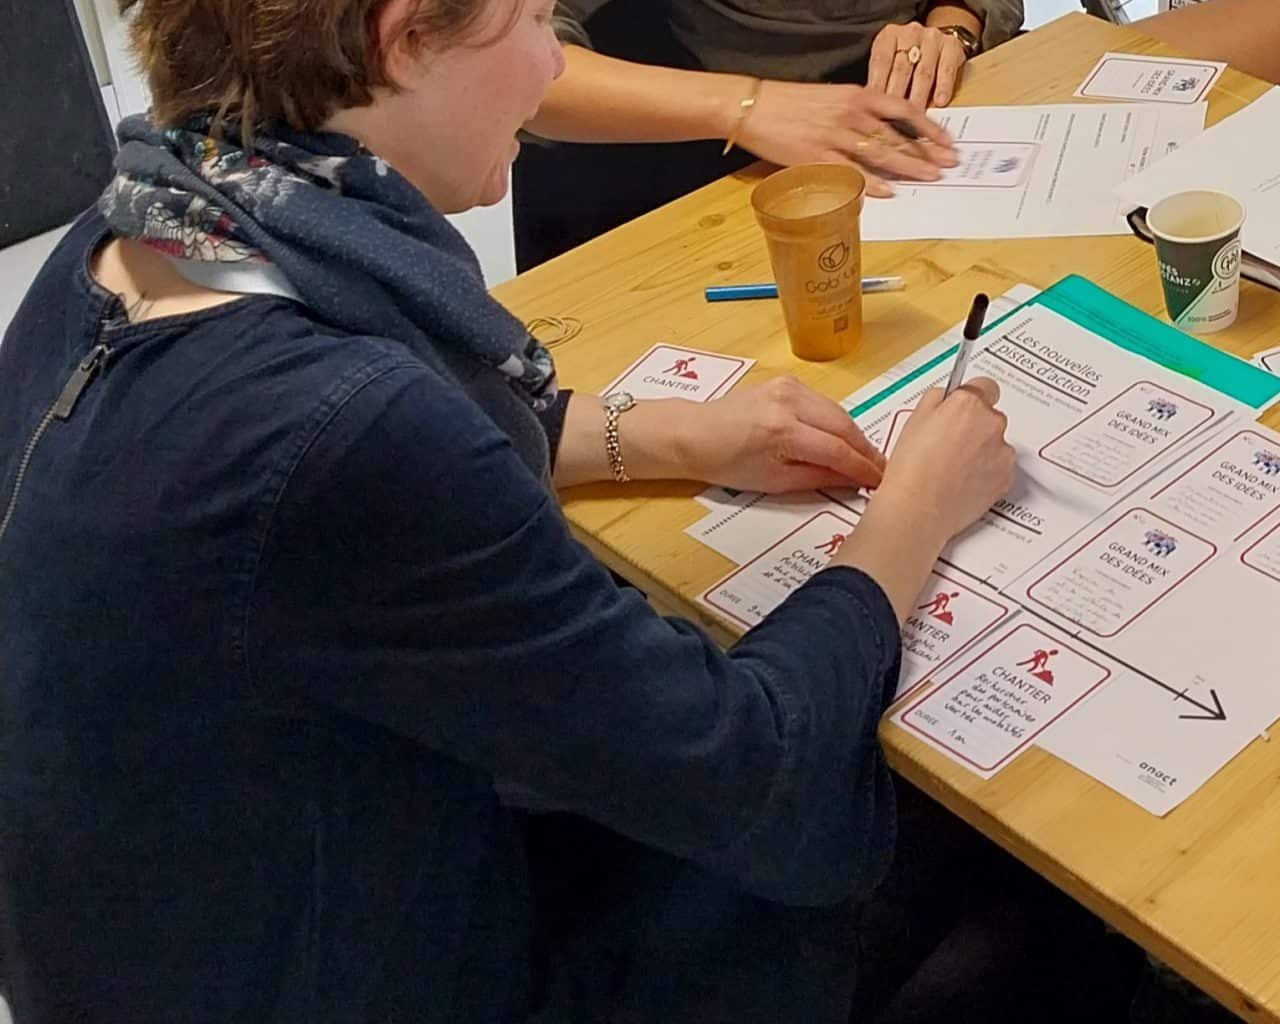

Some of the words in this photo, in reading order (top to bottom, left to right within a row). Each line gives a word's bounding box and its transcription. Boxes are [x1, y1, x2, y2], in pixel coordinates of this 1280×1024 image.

[996, 342, 1037, 370] pistes
[1037, 362, 1091, 397] d'action
[1015, 330, 1040, 349] Les
[1040, 343, 1103, 382] nouvelles
[642, 374, 701, 393] CHANTIER
[1107, 419, 1128, 433] DES
[1115, 409, 1151, 430] GRAND
[1149, 423, 1172, 439] MIX
[1211, 470, 1233, 486] DES
[1219, 460, 1257, 484] GRAND
[1255, 476, 1280, 494] MIX
[993, 497, 1043, 527] antiers
[791, 549, 825, 571] CHAN
[1099, 552, 1122, 570] DES
[1121, 562, 1154, 586] IDÉES
[1107, 541, 1148, 568] GRAND
[1146, 560, 1171, 578] MIX
[992, 666, 1052, 705] CHANTIER
[1139, 759, 1177, 786] anact
